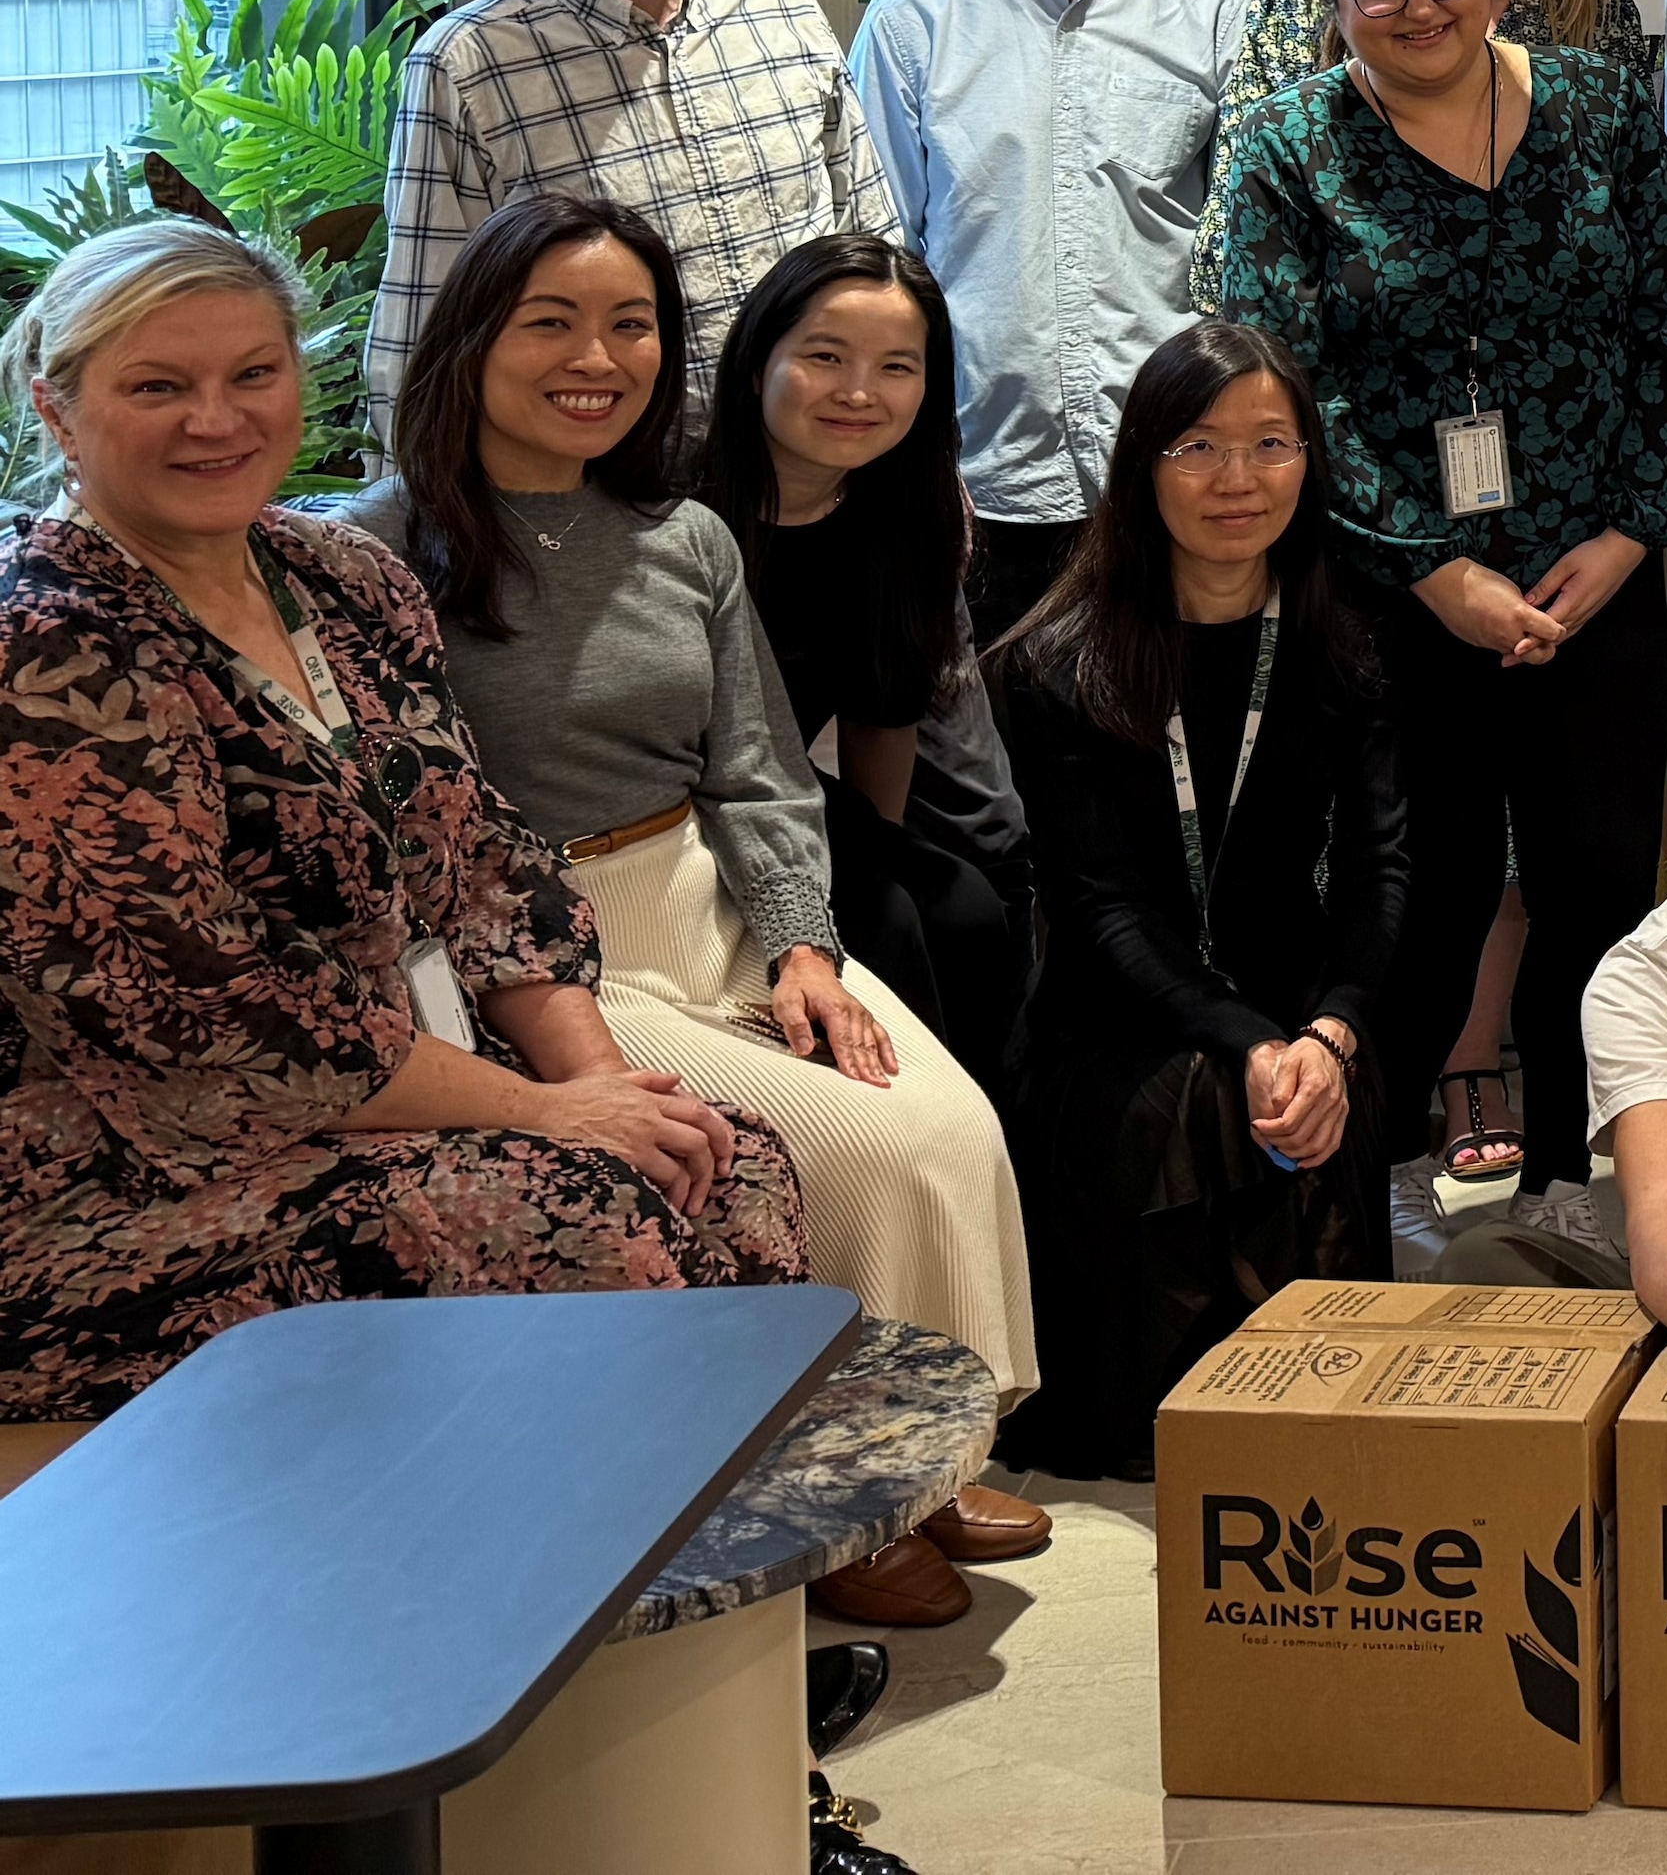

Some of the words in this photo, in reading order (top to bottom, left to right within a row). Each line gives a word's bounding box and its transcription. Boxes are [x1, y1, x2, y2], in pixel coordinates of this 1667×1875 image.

[306, 655, 324, 682] ONE
[276, 694, 305, 720] ONE
[1202, 1494, 1482, 1599] Rise
[1205, 1601, 1338, 1629] AGAINST
[1351, 1607, 1483, 1633] HUNGER
